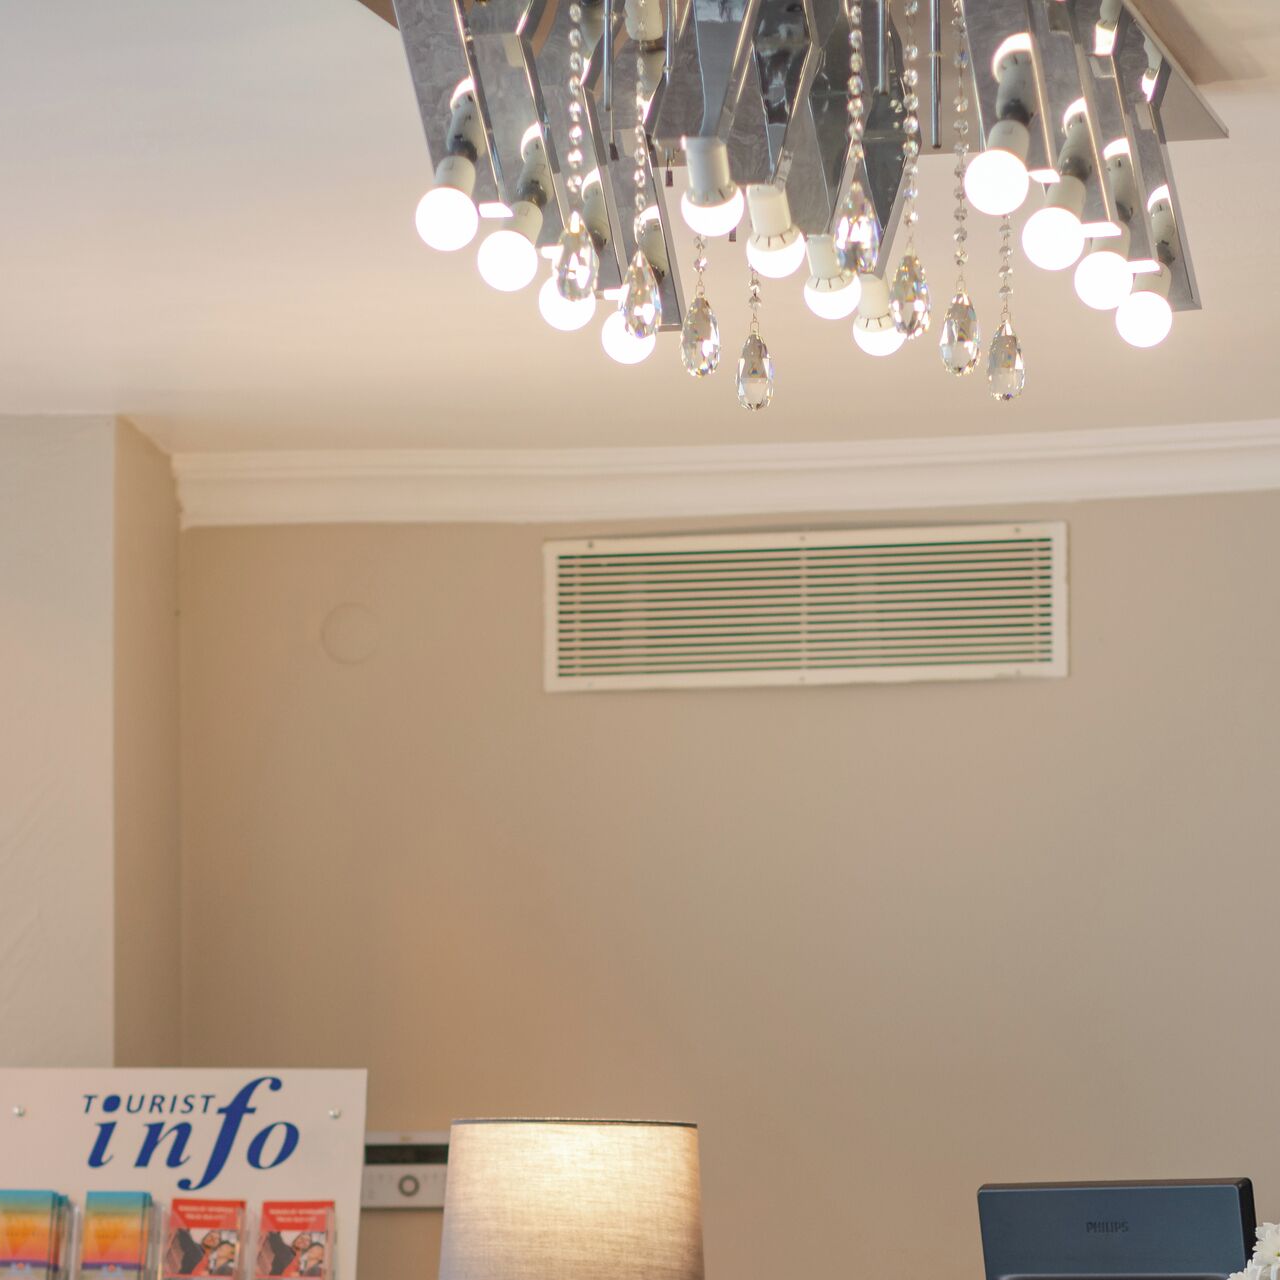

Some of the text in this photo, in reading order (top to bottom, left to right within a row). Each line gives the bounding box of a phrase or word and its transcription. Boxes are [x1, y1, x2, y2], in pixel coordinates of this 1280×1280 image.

[83, 1094, 216, 1114] TOURIST
[87, 1076, 300, 1191] info
[1086, 1221, 1129, 1233] PHILIPS
